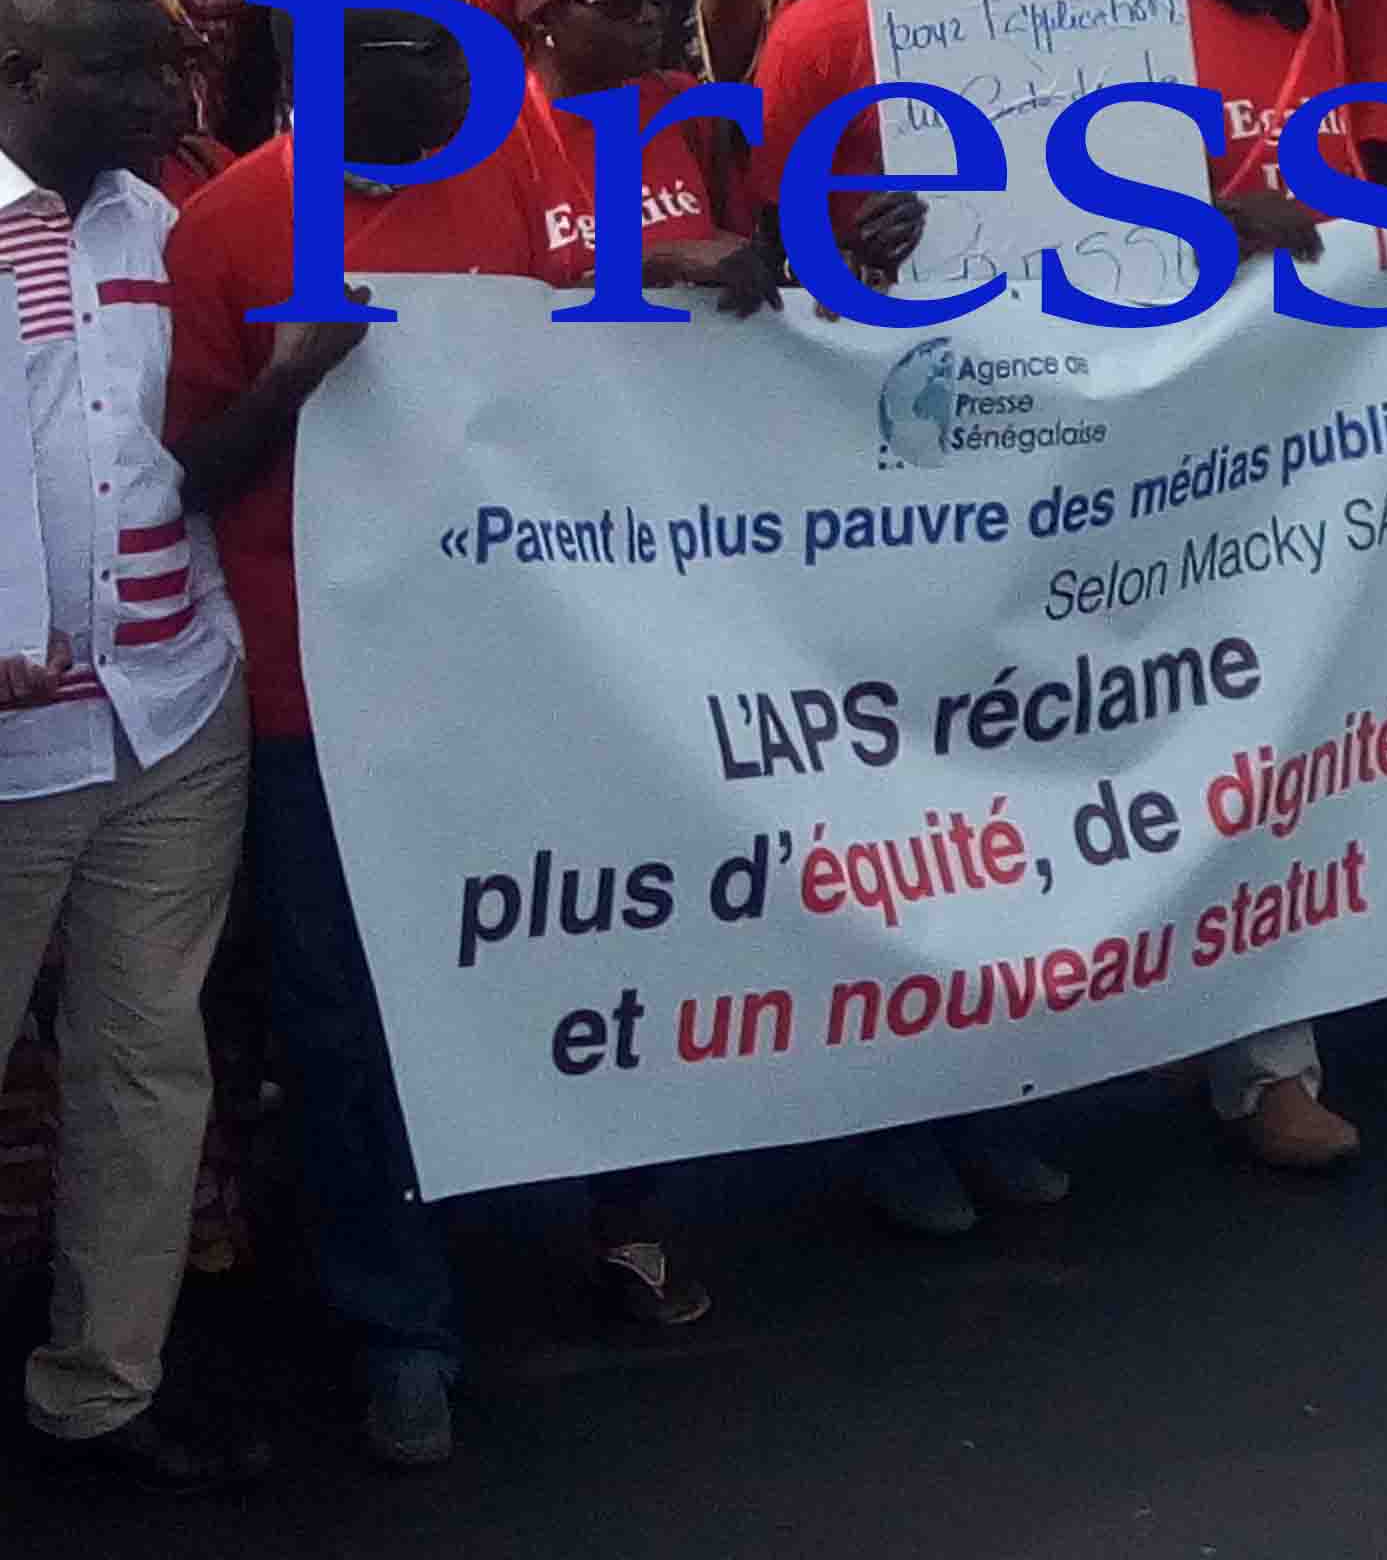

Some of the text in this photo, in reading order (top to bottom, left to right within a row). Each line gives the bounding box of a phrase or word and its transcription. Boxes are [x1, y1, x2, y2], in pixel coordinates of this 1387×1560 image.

[545, 180, 701, 253] Egité
[954, 393, 1034, 417] Presse
[955, 355, 1059, 386] Agence
[950, 417, 1109, 454] Sénégalaise
[626, 505, 657, 565] le
[668, 503, 785, 577] plus
[803, 499, 1010, 567] pauvre
[1028, 484, 1118, 540] des
[1129, 439, 1272, 520] médias
[1044, 560, 1169, 622] Selon
[1180, 514, 1328, 591] Macky
[706, 635, 1262, 782] L'APS réclame
[455, 846, 676, 969] plus
[1072, 778, 1181, 869] de
[551, 840, 1370, 1077] et un nouveau statut
